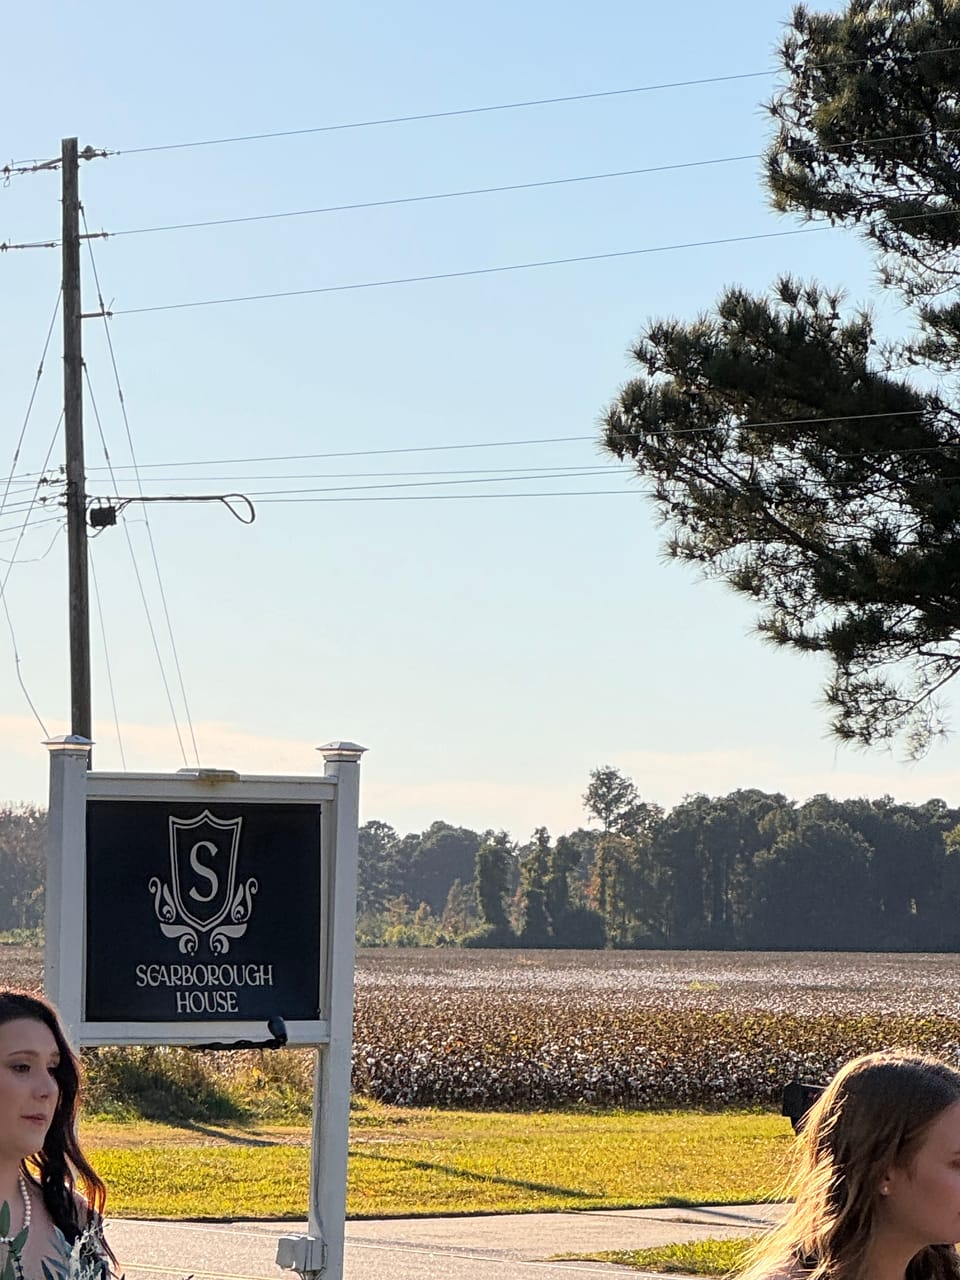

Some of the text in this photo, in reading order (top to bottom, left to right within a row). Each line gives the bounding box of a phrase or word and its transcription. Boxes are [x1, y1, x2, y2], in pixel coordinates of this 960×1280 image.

[188, 840, 219, 903] S
[136, 964, 273, 987] SCARBOROUGH
[176, 990, 239, 1013] HOUSE
